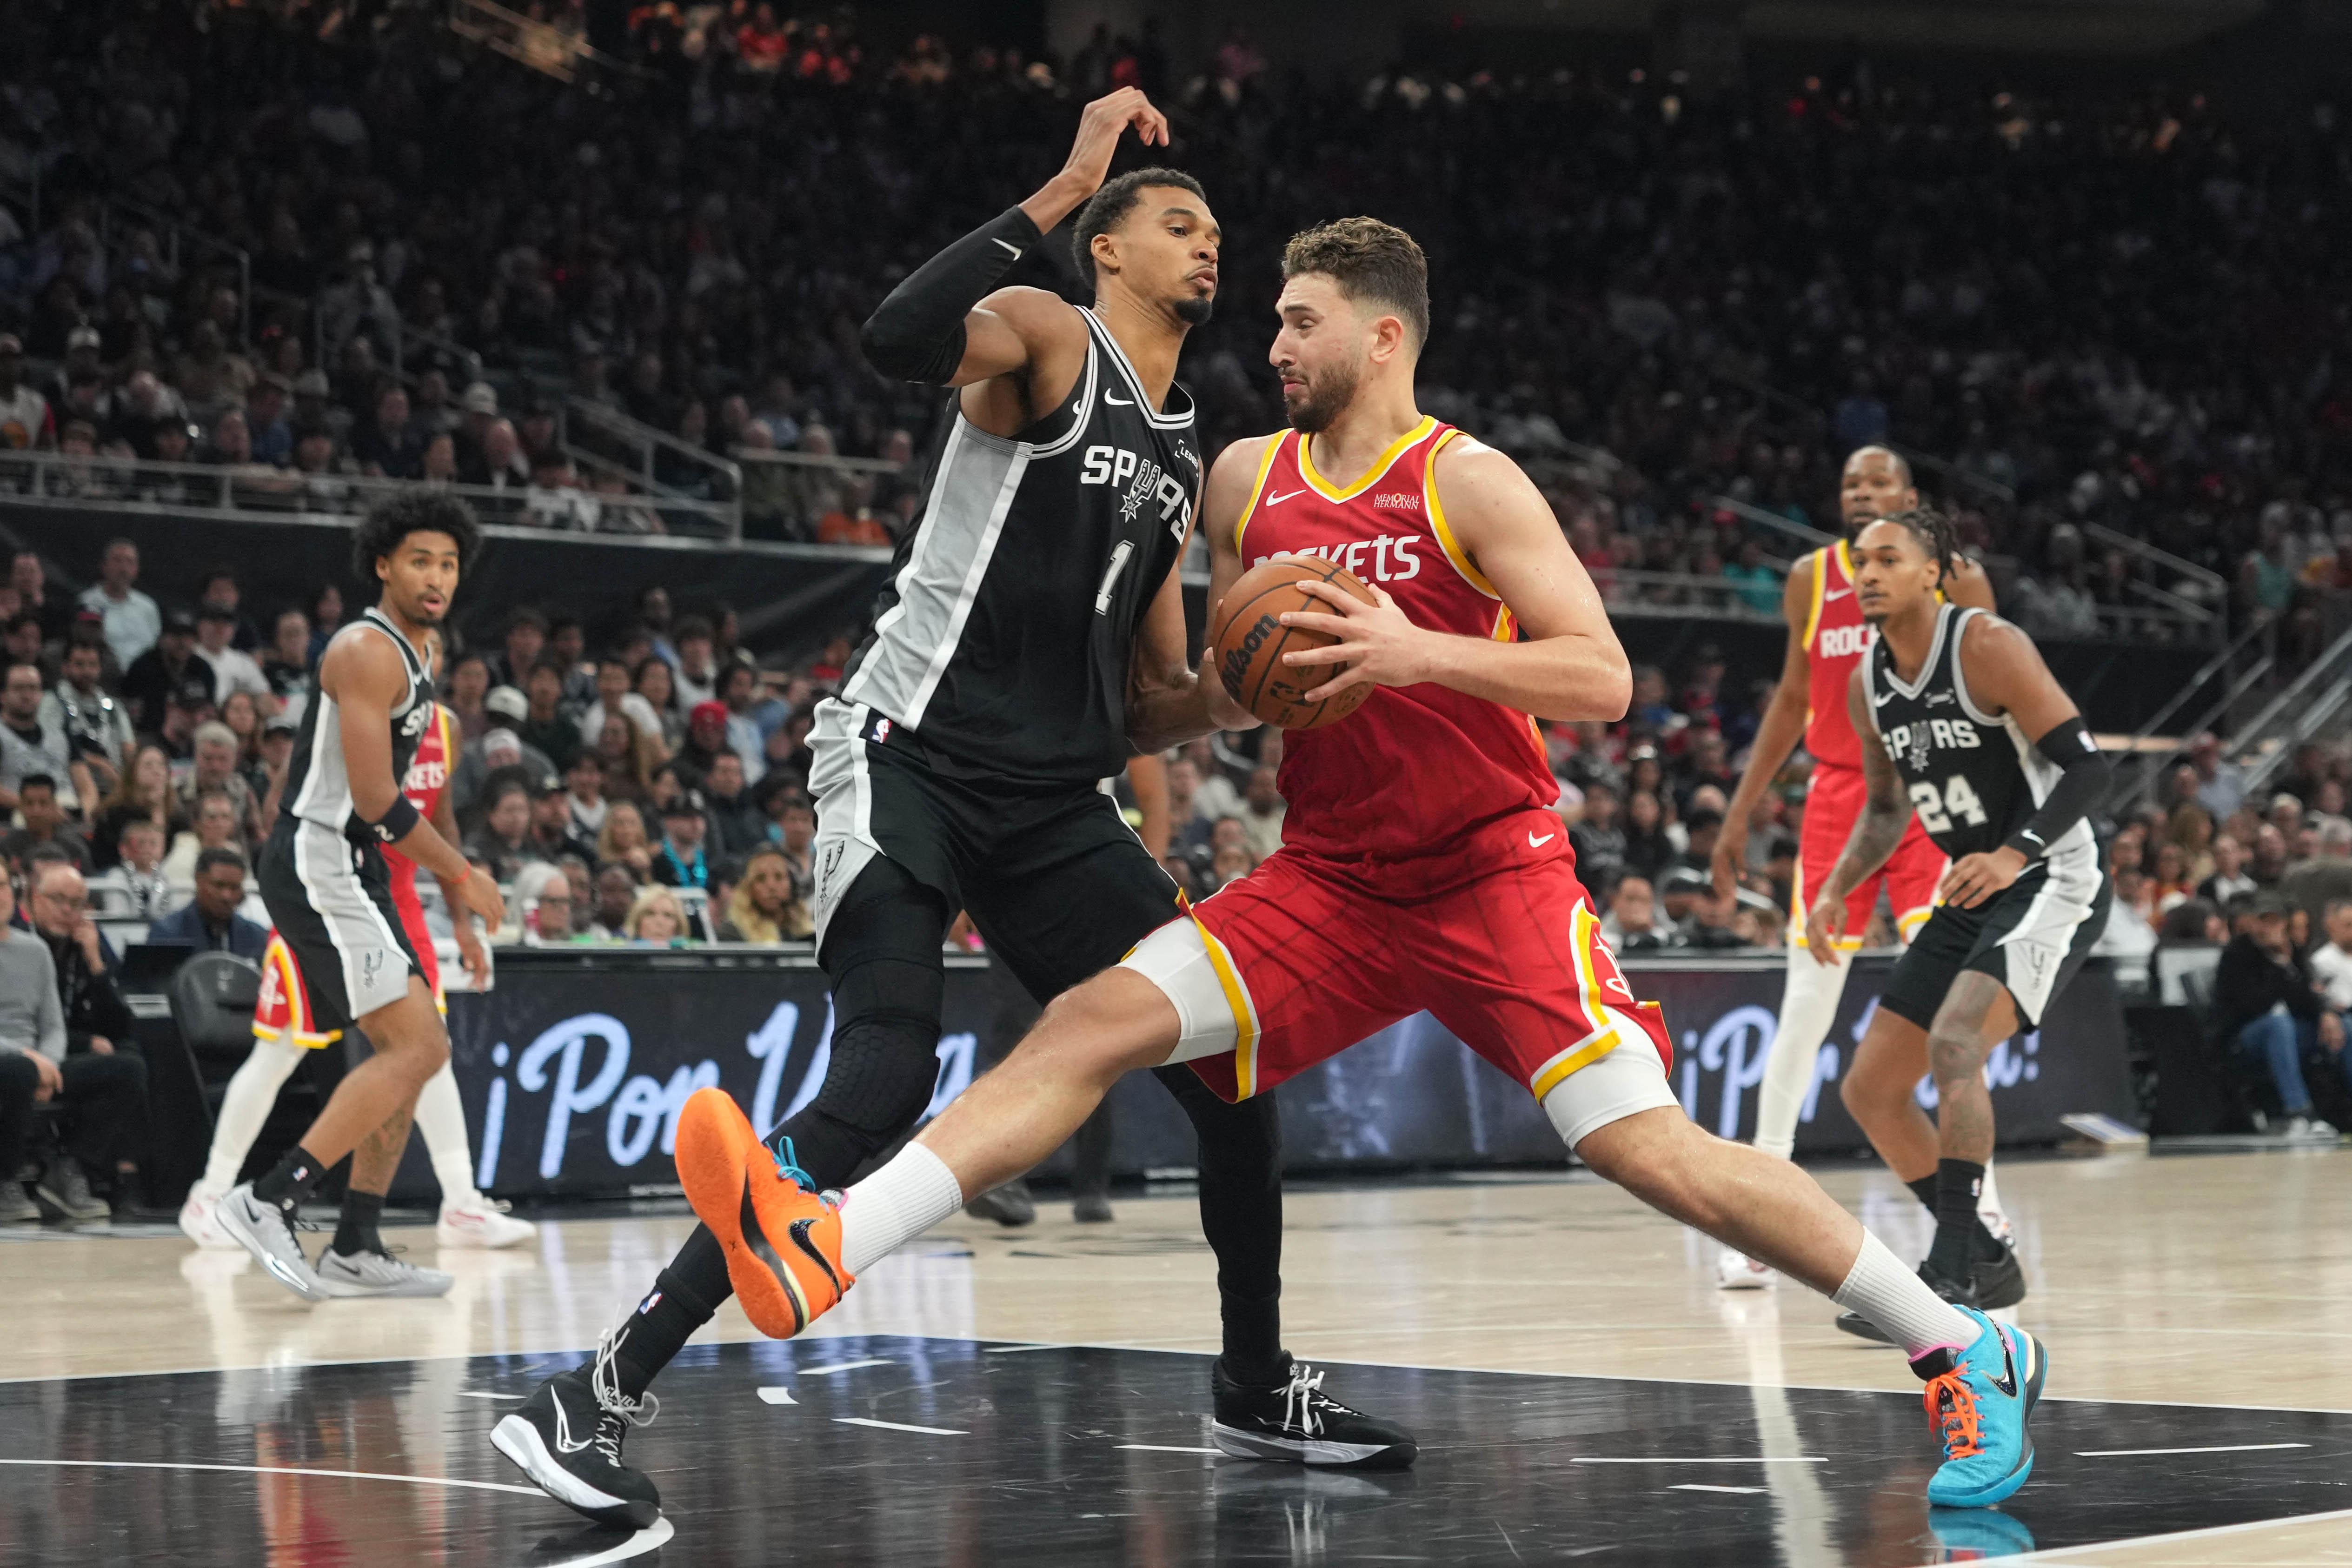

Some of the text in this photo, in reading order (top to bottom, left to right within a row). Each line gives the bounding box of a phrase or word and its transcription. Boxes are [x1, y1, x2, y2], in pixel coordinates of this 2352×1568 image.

[1080, 445, 1191, 545] SPURS
[1373, 500, 1419, 510] HERMANN
[1375, 493, 1419, 503] MEMORIAL
[1095, 539, 1135, 616] 1
[1254, 534, 1421, 584] KETS
[1820, 623, 1880, 658] ROCK
[1908, 778, 1989, 834] 24
[1680, 1003, 1839, 1139] ¡Pr
